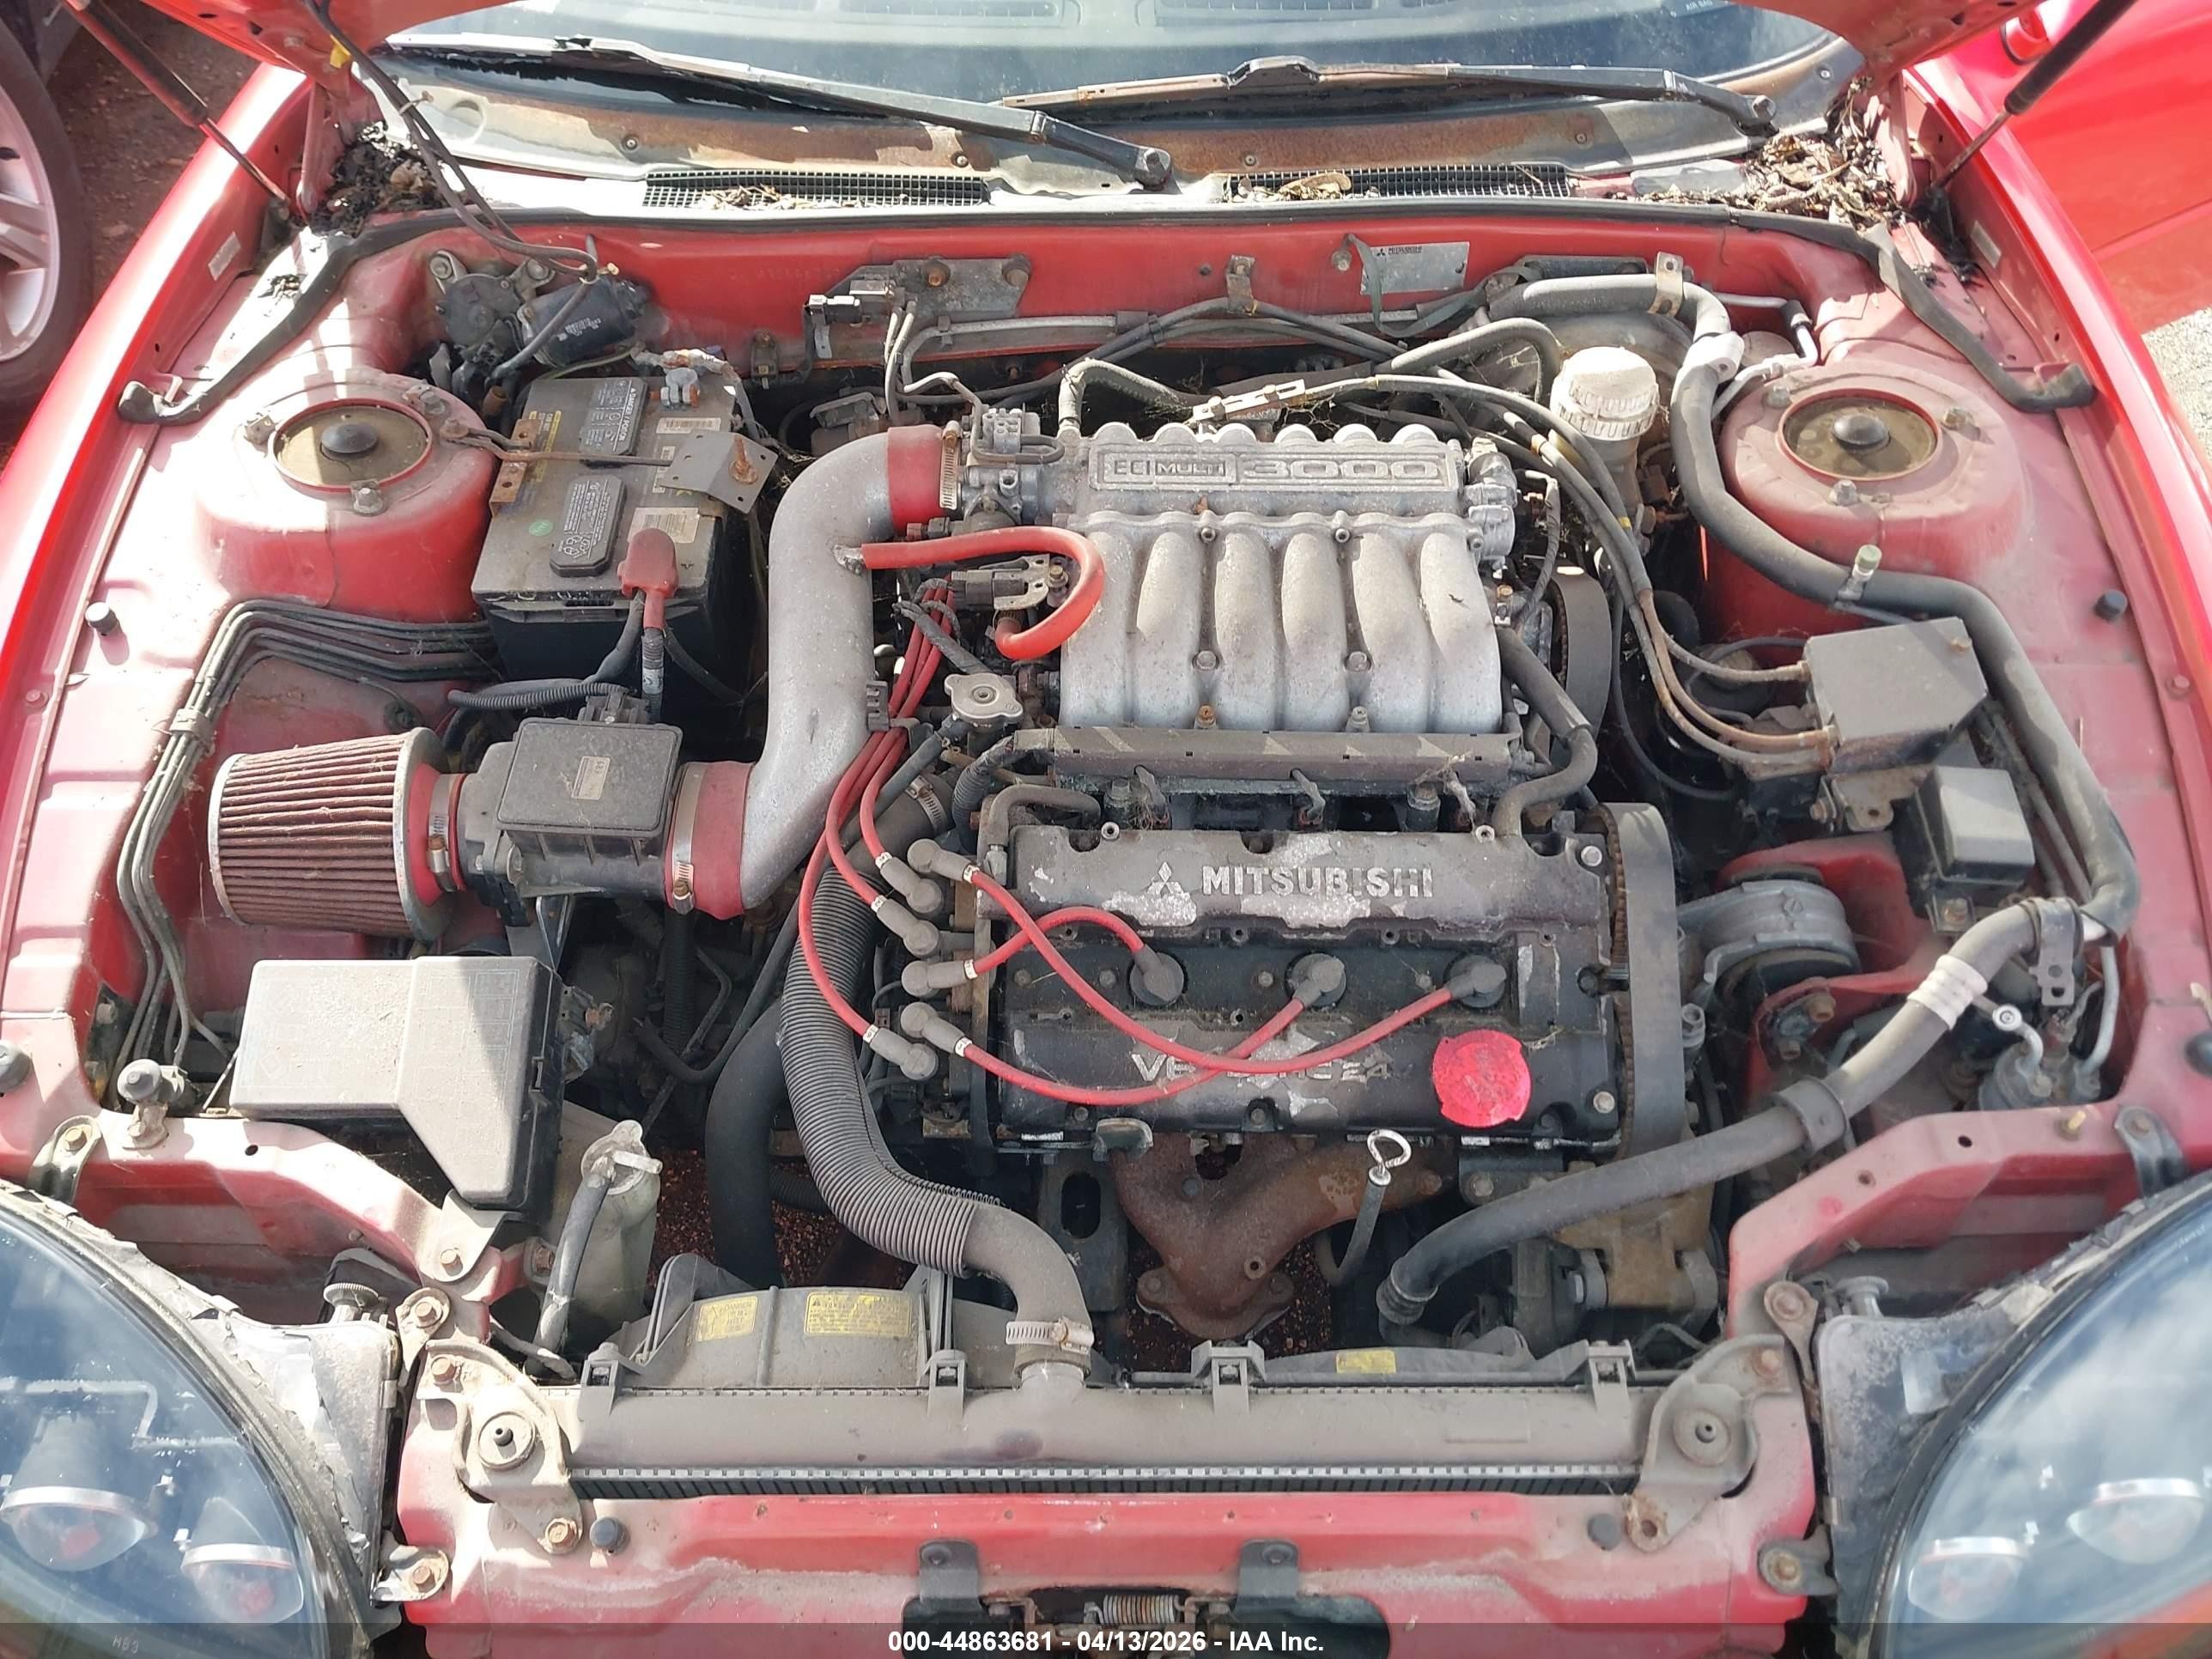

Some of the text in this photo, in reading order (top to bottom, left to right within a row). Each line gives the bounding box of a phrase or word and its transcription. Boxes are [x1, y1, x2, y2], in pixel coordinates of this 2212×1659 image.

[1115, 459, 1441, 479] ECI MULTI 3000
[1202, 865, 1433, 898] MITSUBISHI
